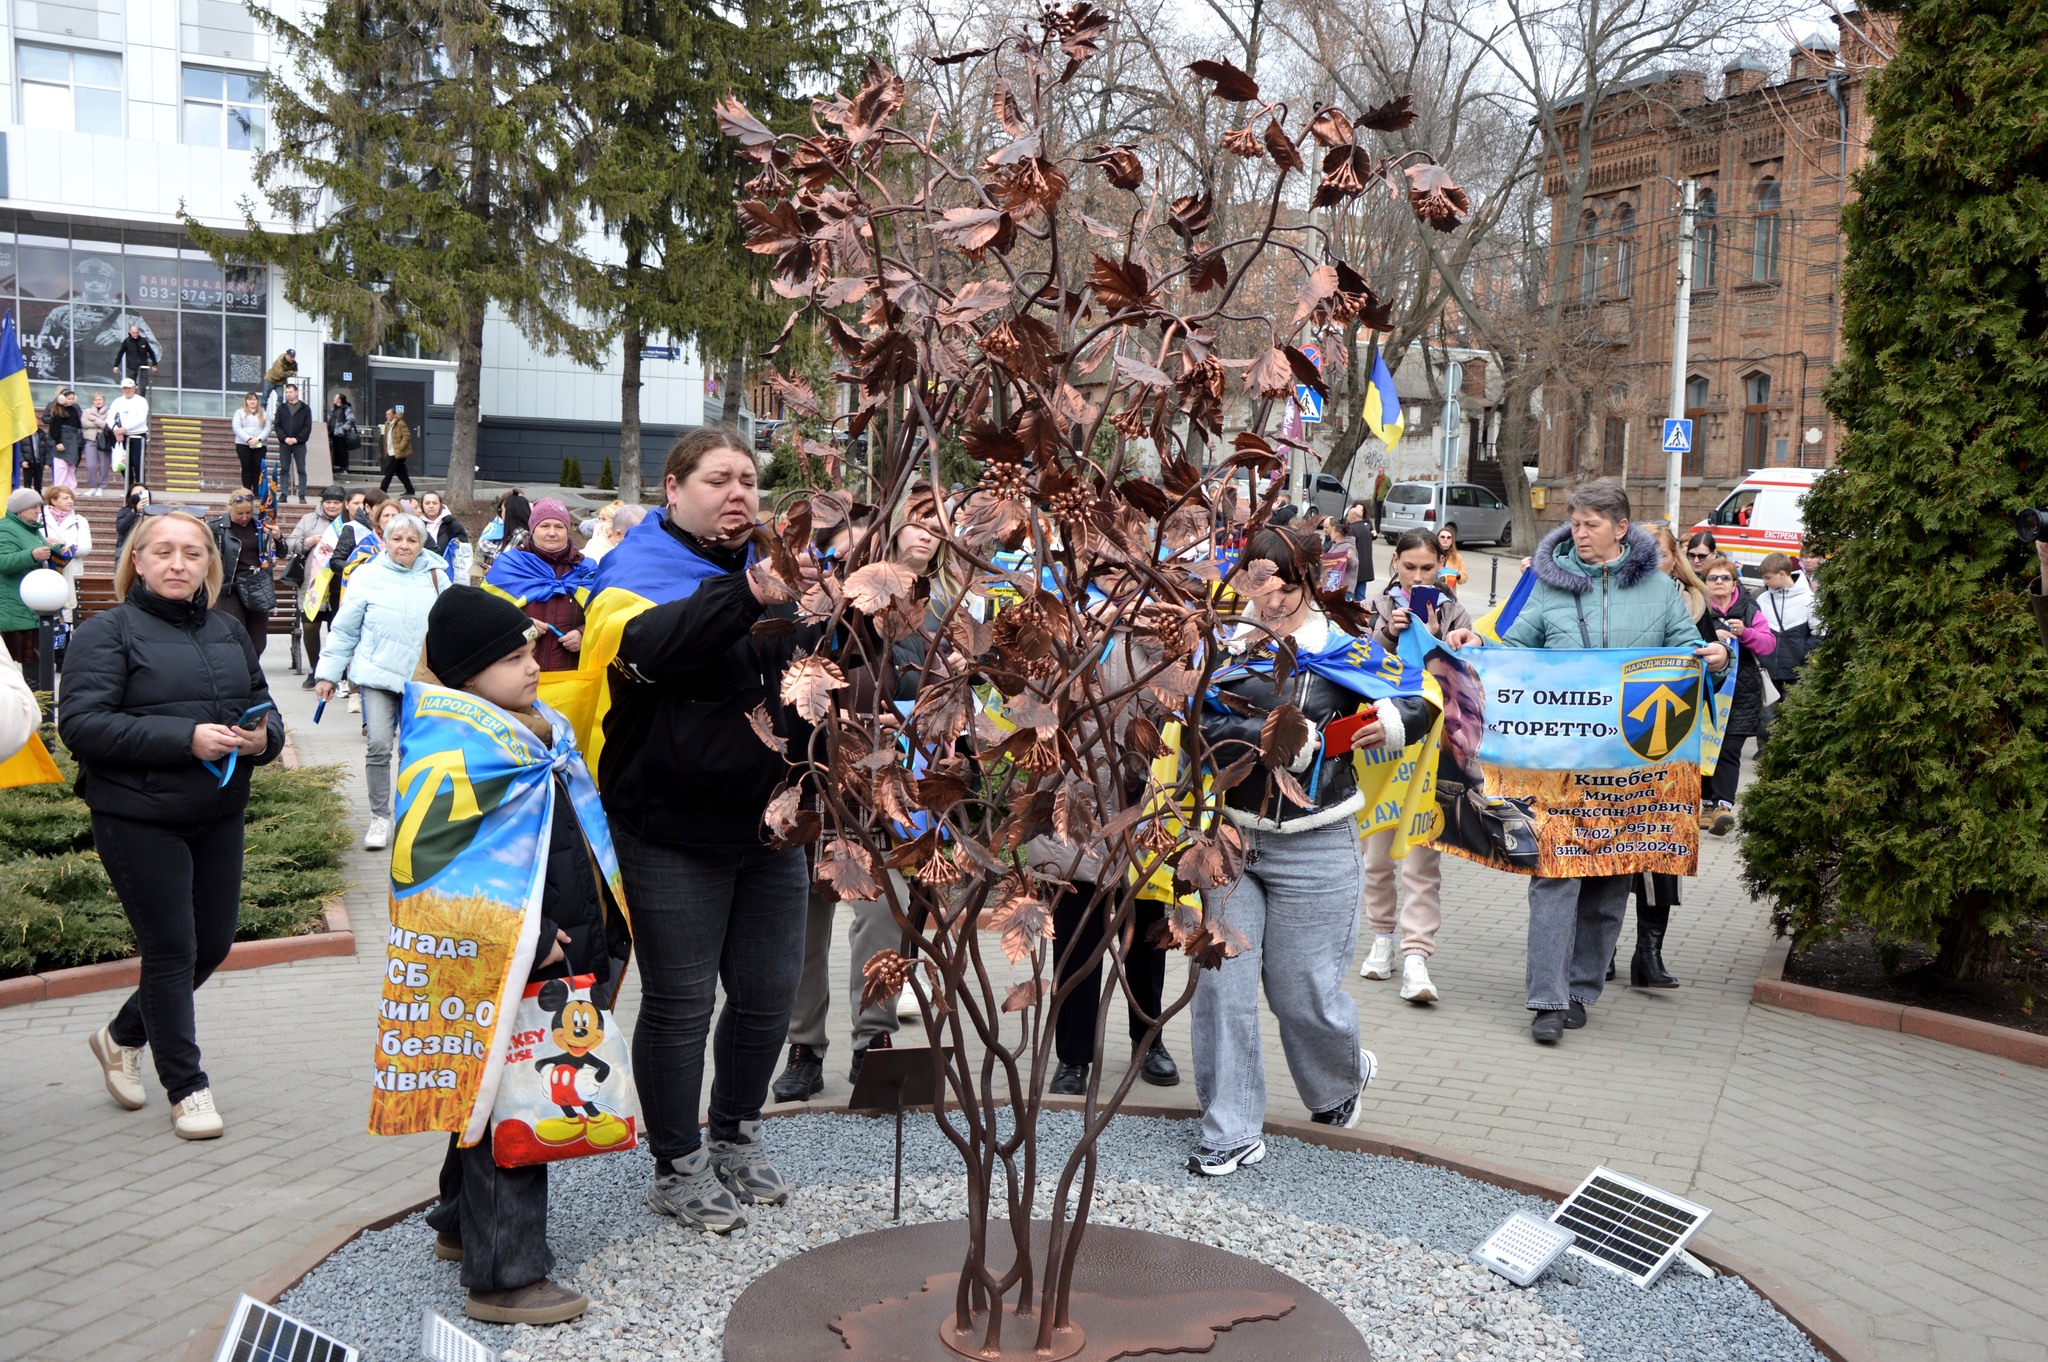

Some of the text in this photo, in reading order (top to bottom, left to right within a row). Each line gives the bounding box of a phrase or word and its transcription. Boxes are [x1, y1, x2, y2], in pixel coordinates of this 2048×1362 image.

[139, 286, 258, 306] 093-374-70-33
[1764, 530, 1798, 540] ЕКСТРЕНА
[1625, 659, 1675, 674] НАРОДЖЕНІ
[1497, 689, 1525, 704] 57
[422, 697, 505, 733] НАРОДЖЕНІ
[1488, 720, 1619, 738] «ТОРЕТТО»
[1574, 770, 1668, 788] Кшебет
[1585, 788, 1655, 802] Микола
[507, 1027, 546, 1050] KEY
